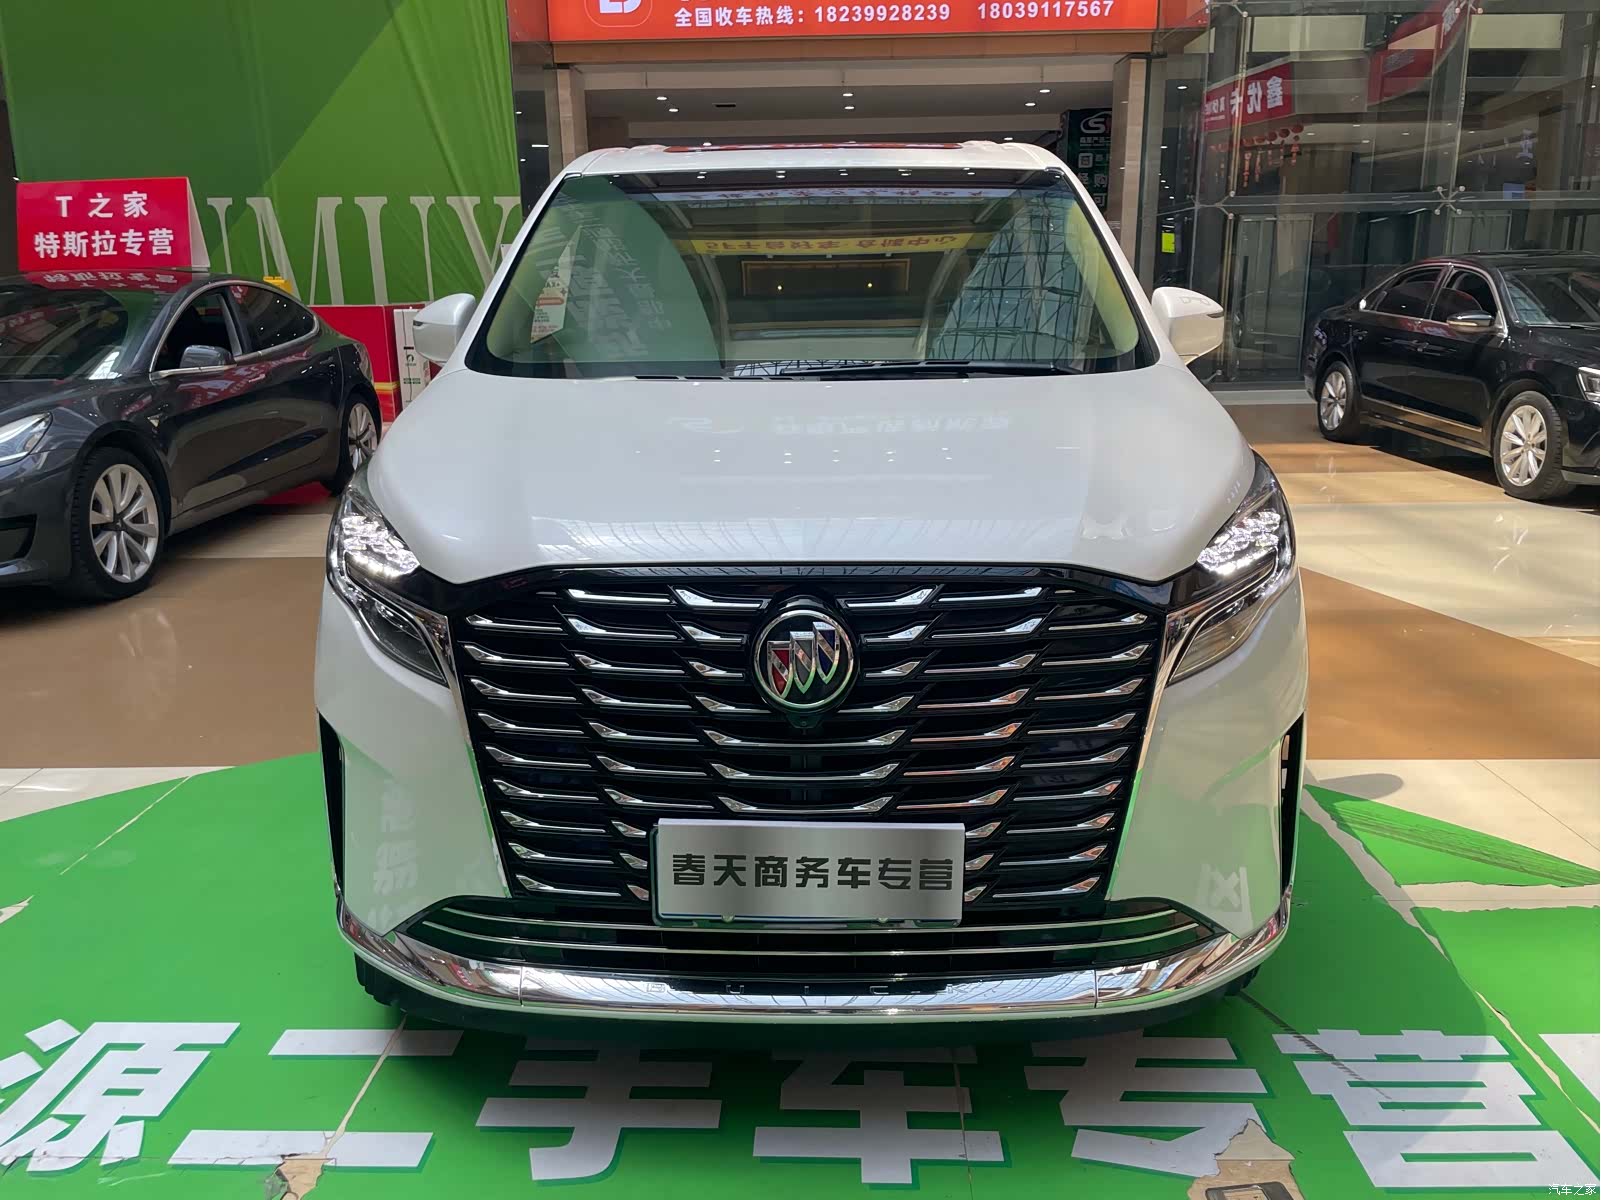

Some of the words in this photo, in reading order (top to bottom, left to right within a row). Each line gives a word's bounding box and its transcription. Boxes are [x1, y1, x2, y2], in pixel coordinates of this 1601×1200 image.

[978, 0, 1113, 20] 18039117567
[33, 228, 175, 260] 特斯拉专营
[672, 853, 953, 891] 春天商务车专营
[0, 1018, 1601, 1188] 源二手车专营
